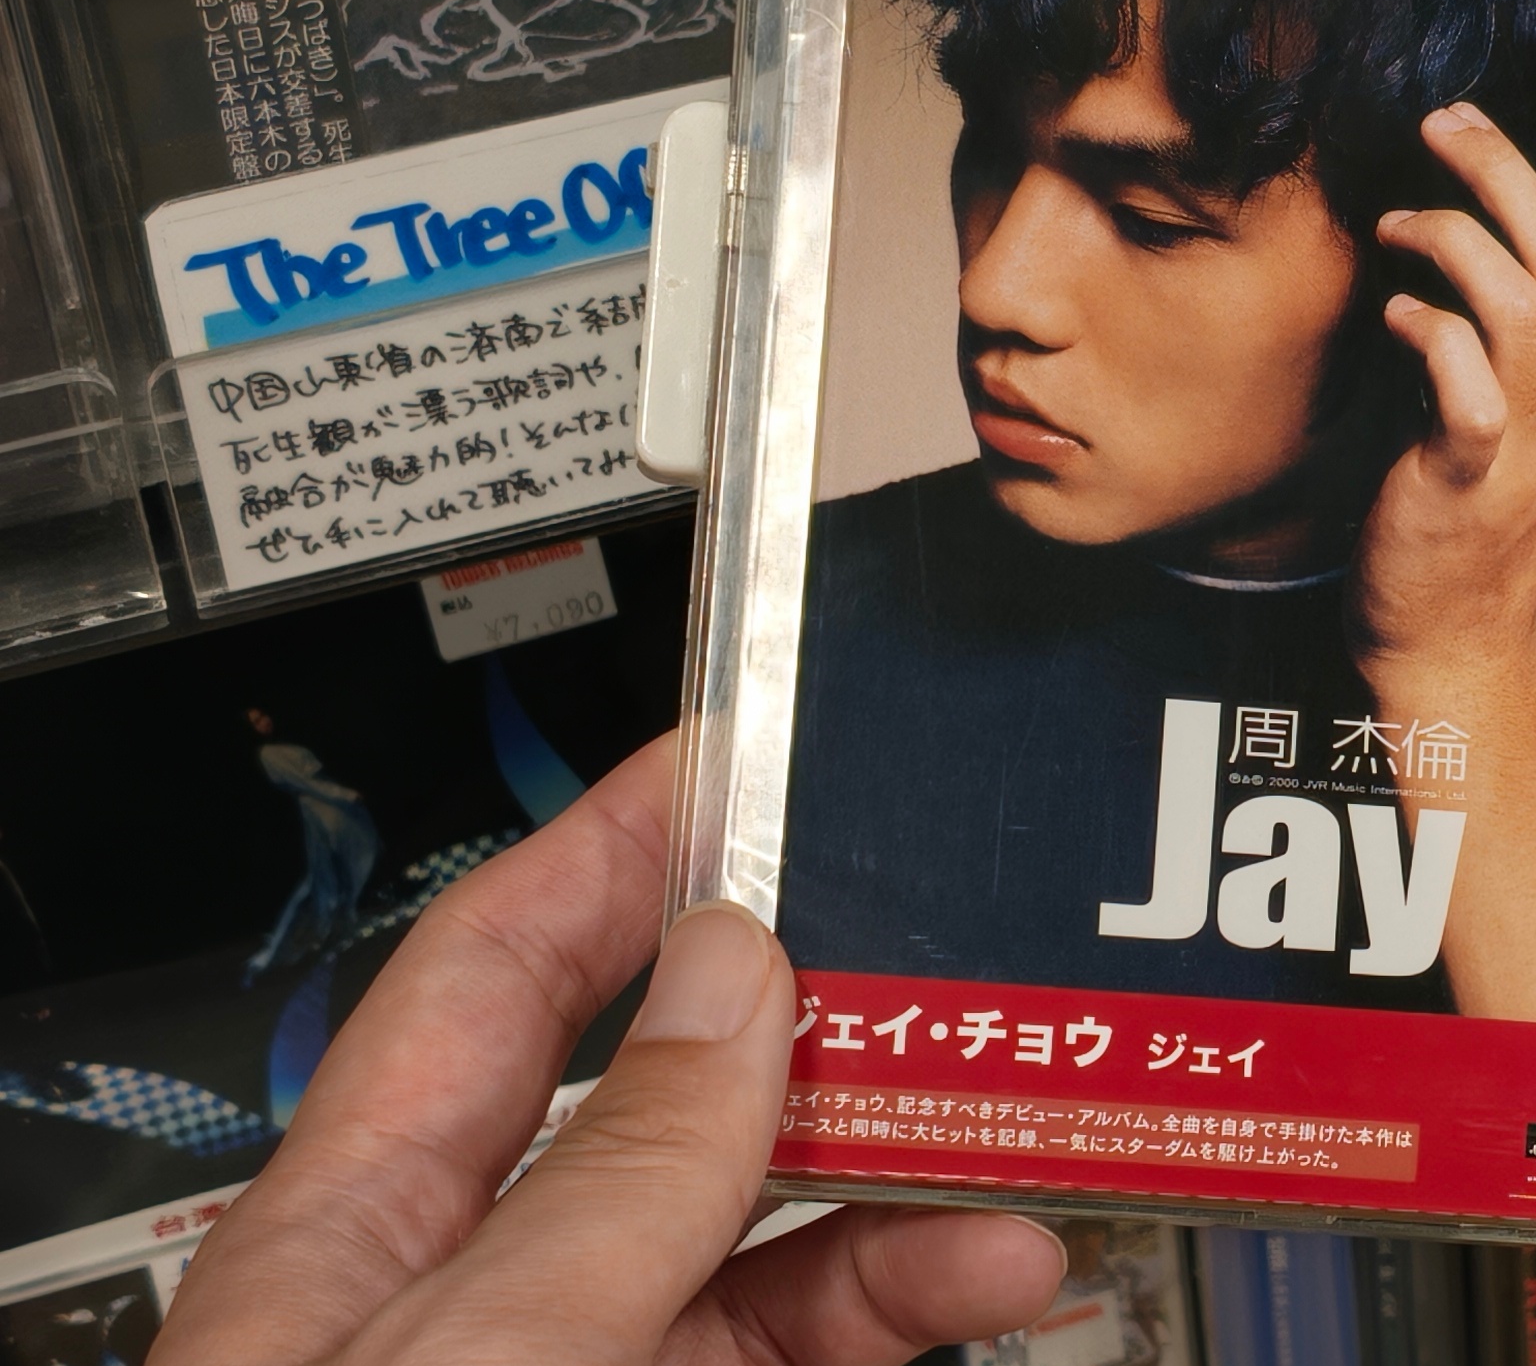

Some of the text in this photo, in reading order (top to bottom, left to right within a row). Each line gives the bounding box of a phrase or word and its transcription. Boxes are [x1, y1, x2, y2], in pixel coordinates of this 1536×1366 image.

[183, 237, 370, 326] The
[350, 200, 558, 282] Tree
[1303, 779, 1328, 791] JVR
[1331, 780, 1366, 795] Music
[1370, 785, 1442, 800] International
[1098, 698, 1468, 977] Jay
[1147, 1032, 1267, 1078] ジェイ
